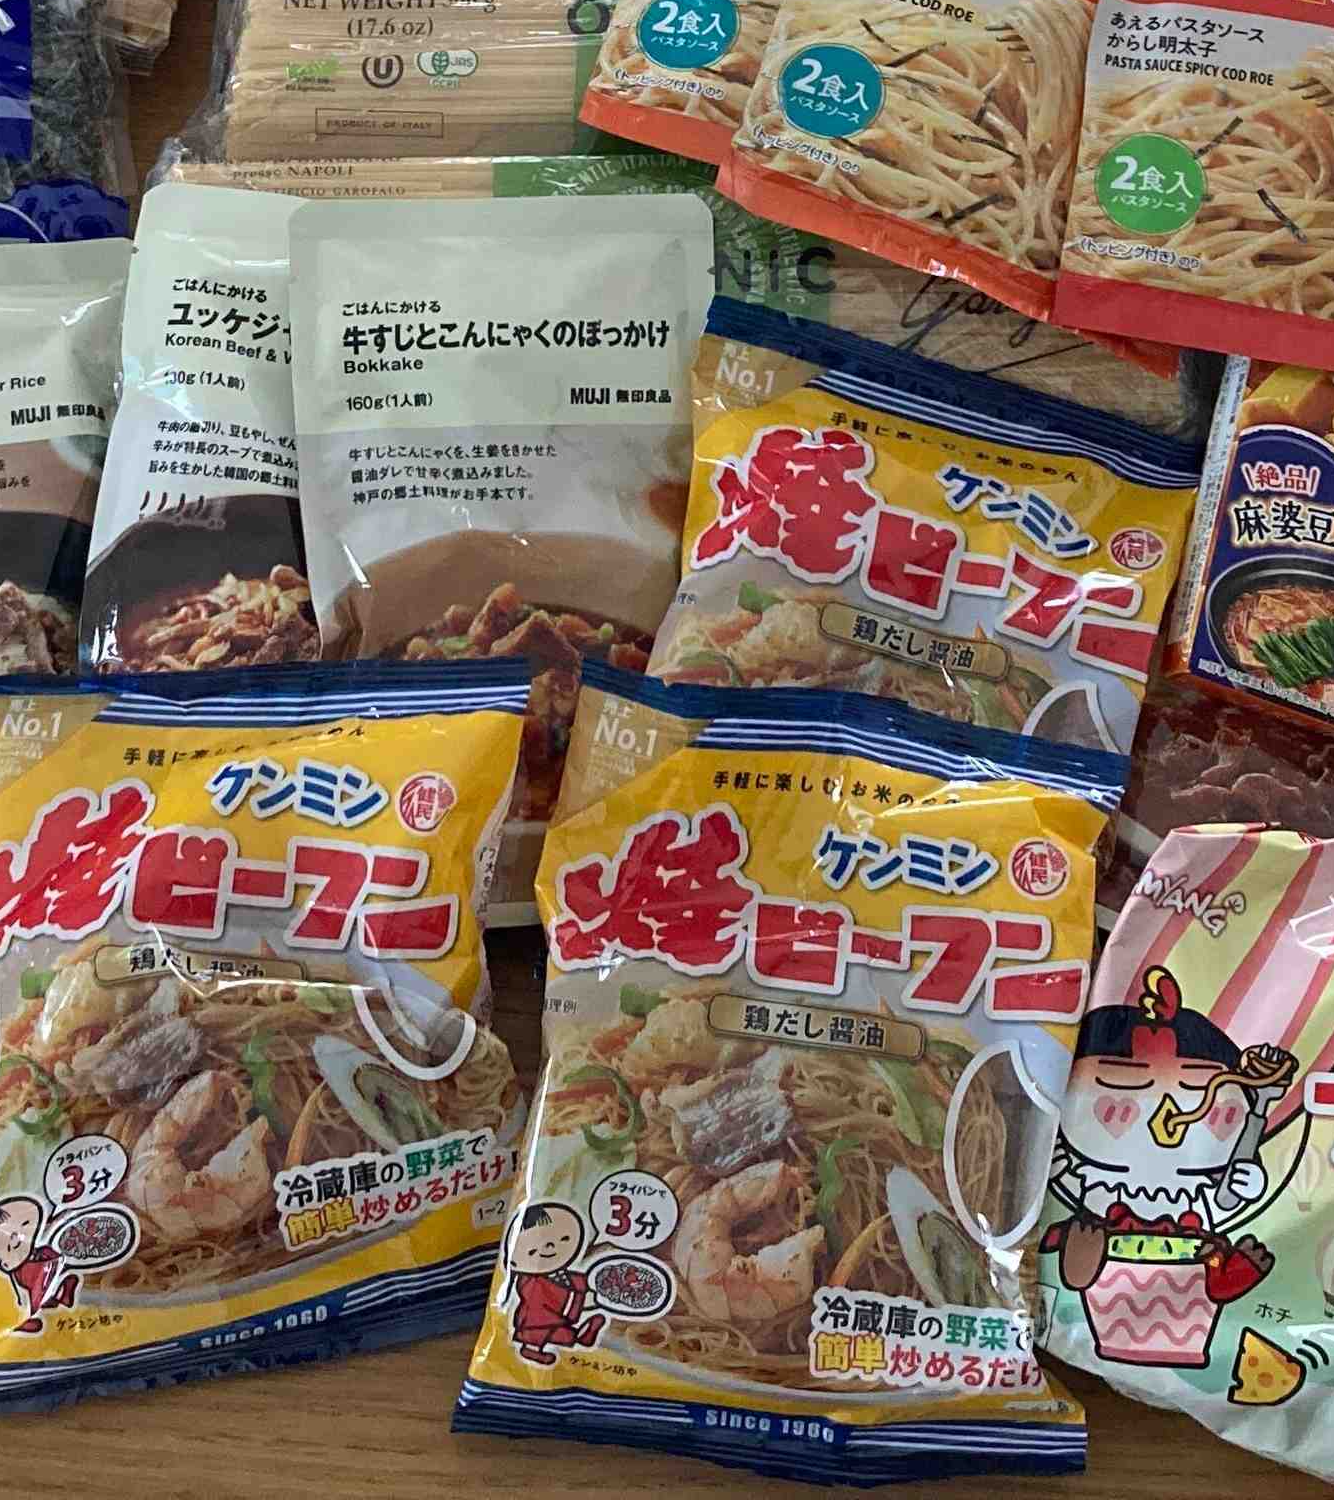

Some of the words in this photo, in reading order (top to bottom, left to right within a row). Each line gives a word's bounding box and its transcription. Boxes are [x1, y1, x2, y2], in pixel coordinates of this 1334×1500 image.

[346, 16, 396, 40] (17.6
[401, 16, 435, 40] oz)
[943, 3, 975, 23] ROE
[1109, 11, 1266, 44] あえるパスタソース
[1106, 32, 1218, 59] からし明太子
[1104, 53, 1143, 71] PASTA
[1144, 57, 1183, 74] SAUCE
[1185, 61, 1220, 78] SPICY
[1221, 66, 1248, 82] COD
[1249, 71, 1275, 86] ROE
[171, 277, 268, 304] ごはんにかける
[341, 299, 442, 317] ごはんにかける
[342, 318, 671, 355] 牛すじとこんにゃくのぼっかけ
[10, 373, 47, 391] Rice
[342, 355, 424, 375] Bokkake
[569, 386, 611, 405] MUJI
[615, 387, 673, 405] 無印良品
[1253, 463, 1309, 492] 絶品
[937, 464, 1099, 560] ケンミン
[851, 612, 975, 670] 鶏だし醤油
[1, 710, 62, 742] No.1
[592, 715, 658, 758] No.1
[207, 759, 389, 826] ケンミン
[815, 827, 995, 892] ケンミン
[550, 806, 1091, 1022] 焼ビーフン
[741, 1003, 886, 1049] 鶏だし醤油
[54, 1142, 114, 1166] フライパンで
[279, 1131, 489, 1207] 冷蔵庫の野菜で
[60, 1161, 112, 1200] 3分
[283, 1151, 521, 1252] 簡単炒めるだけ!
[605, 1204, 663, 1242] 3分
[198, 1324, 265, 1352] Since
[271, 1303, 328, 1338] 1960
[813, 1334, 1045, 1390] 簡単炒めるだけ
